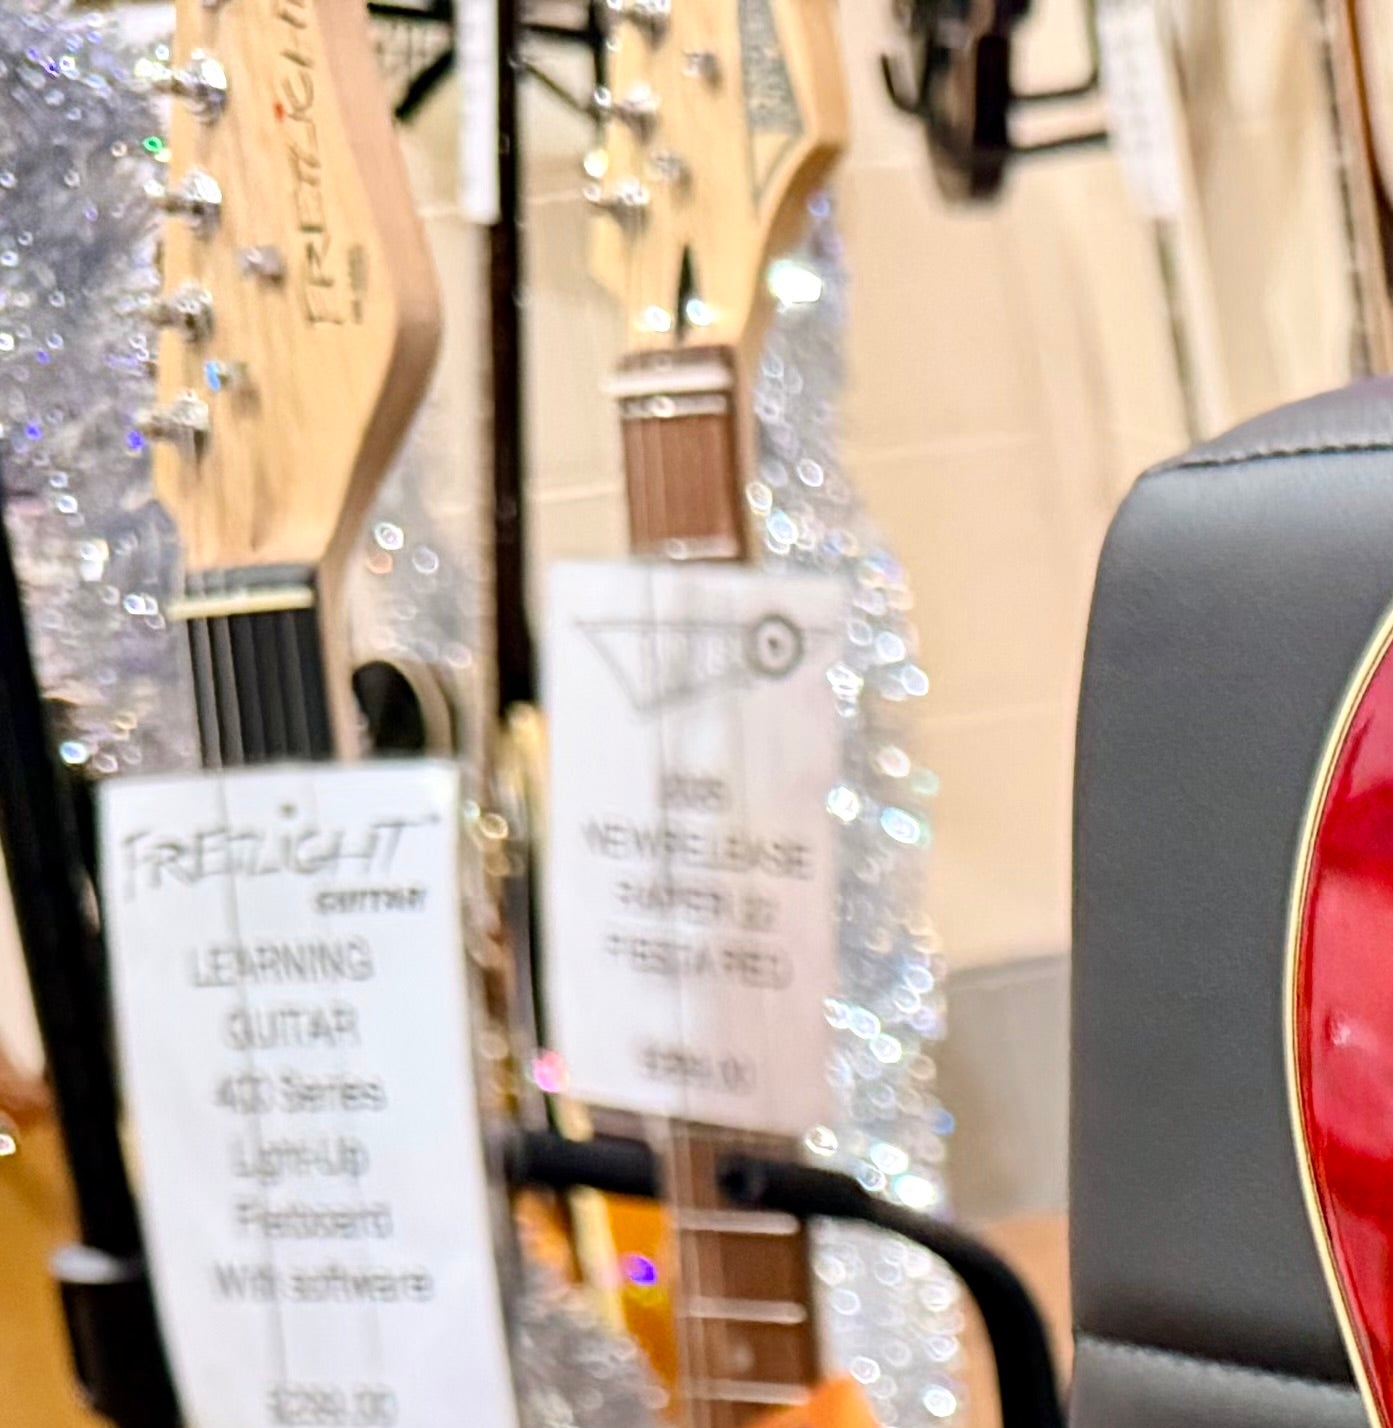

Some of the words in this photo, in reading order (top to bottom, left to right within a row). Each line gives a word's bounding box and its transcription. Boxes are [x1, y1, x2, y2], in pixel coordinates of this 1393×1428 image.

[192, 935, 375, 988] LEARNING
[223, 1003, 361, 1050] GUITAR
[277, 1069, 388, 1114] Series
